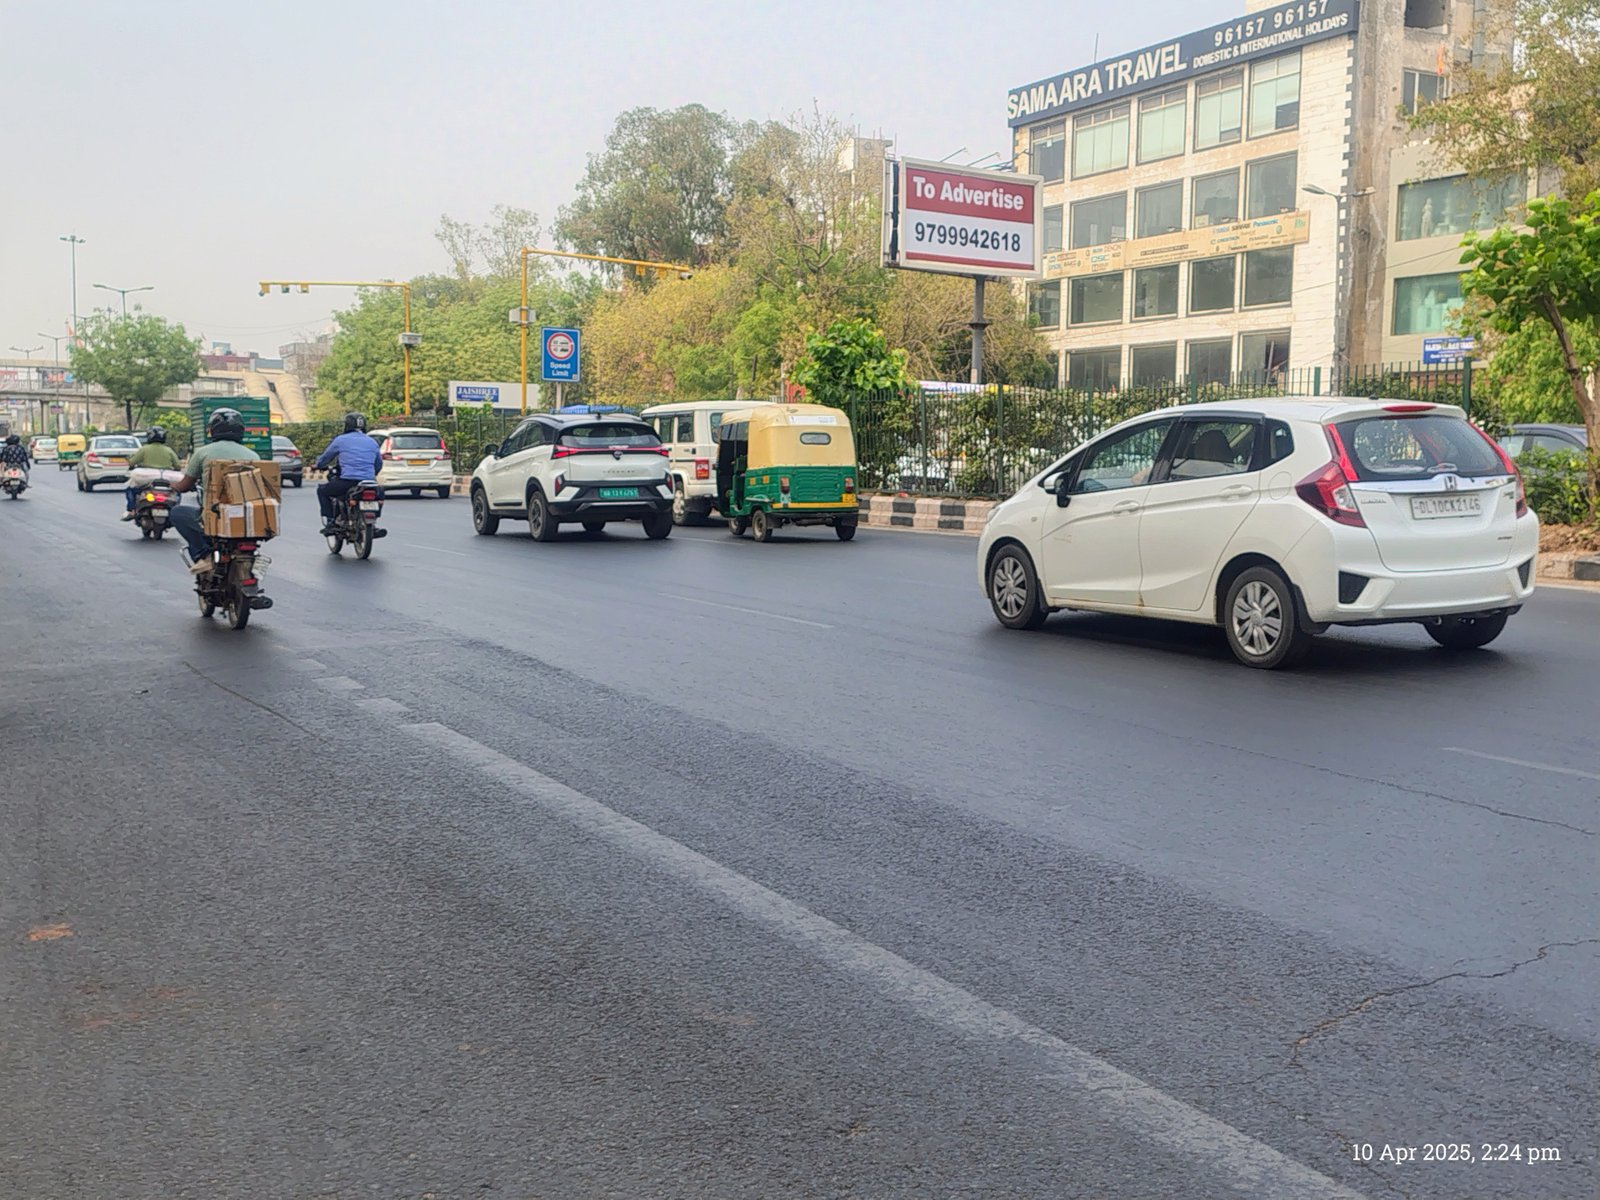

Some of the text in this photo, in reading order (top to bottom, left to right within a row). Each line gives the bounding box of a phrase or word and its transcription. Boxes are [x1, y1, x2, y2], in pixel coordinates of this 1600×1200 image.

[1193, 12, 1349, 69] DOMESTIC & INTERNATIONAL HOLIDAYS
[1214, 0, 1329, 47] 96157 96157
[1105, 42, 1188, 92] TRAVEL
[913, 176, 1025, 211] To Advertise
[914, 221, 1021, 253] 9799942618
[550, 361, 571, 370] Speed
[551, 369, 569, 377] Limit
